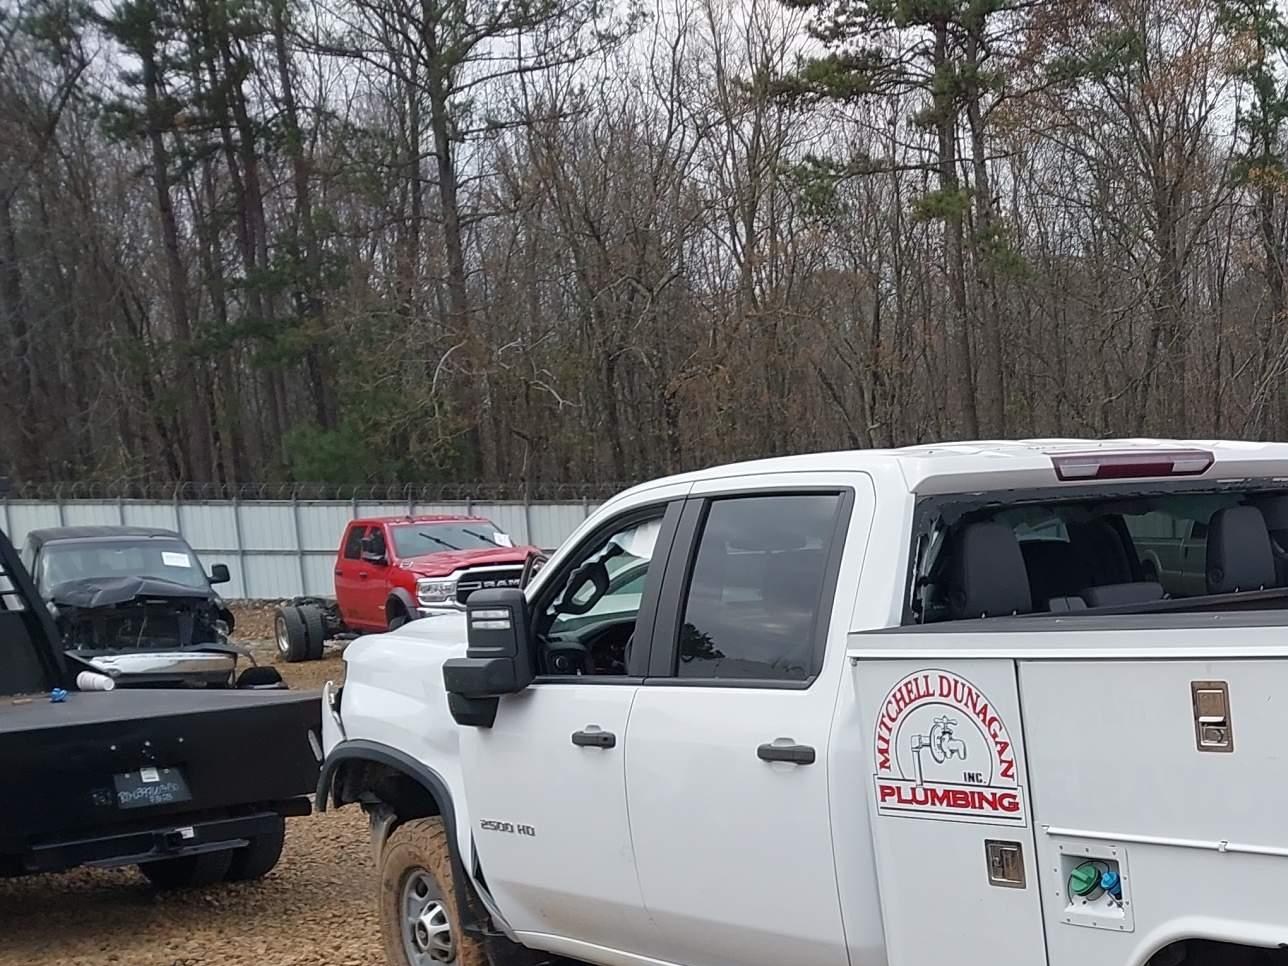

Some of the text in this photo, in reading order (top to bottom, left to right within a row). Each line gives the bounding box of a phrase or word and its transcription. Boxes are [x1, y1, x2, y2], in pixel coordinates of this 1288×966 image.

[483, 579, 521, 588] RAM
[877, 674, 1015, 781] MITCHELL DUNAGAN
[963, 771, 987, 784] INC.
[879, 784, 1020, 812] PLUMBING
[480, 819, 536, 837] 2500 HD
